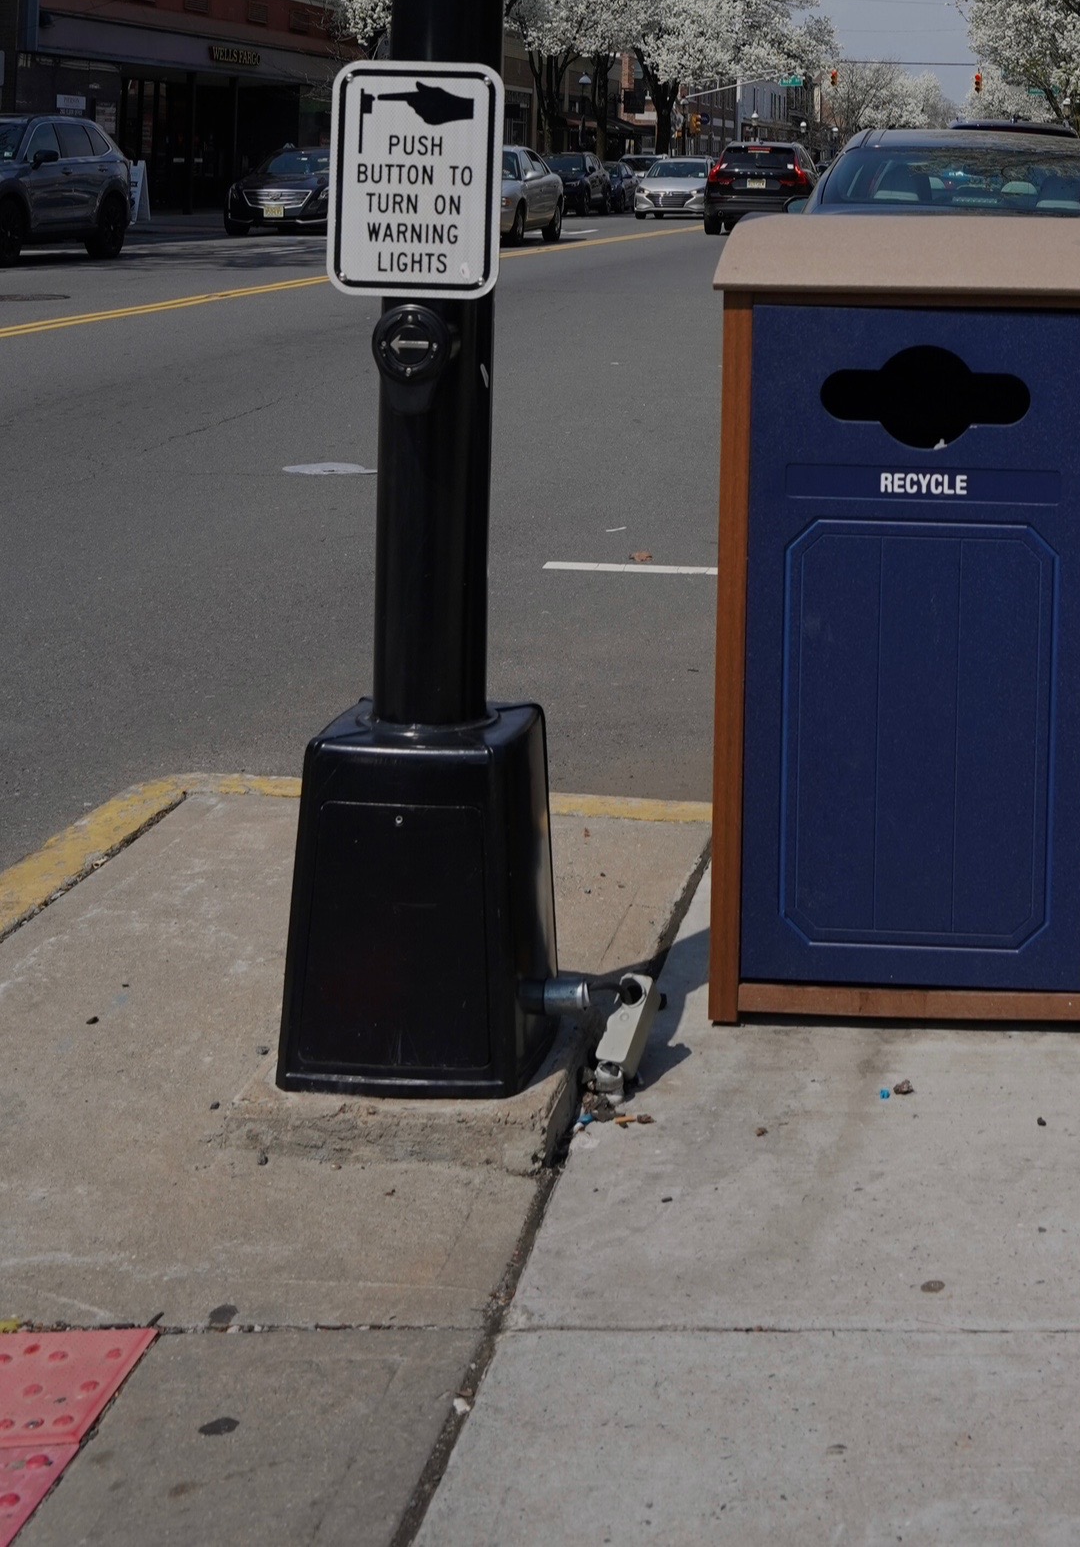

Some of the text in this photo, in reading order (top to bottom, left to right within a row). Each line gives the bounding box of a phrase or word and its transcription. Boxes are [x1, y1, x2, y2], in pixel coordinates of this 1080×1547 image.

[212, 45, 261, 65] WELLS FARGO
[388, 135, 444, 156] PUSH
[357, 164, 473, 186] BUTTON TO
[366, 192, 461, 216] TURN ON
[367, 222, 459, 245] WARNING
[377, 252, 448, 274] LIGHTS
[879, 472, 968, 496] RECYCLE
